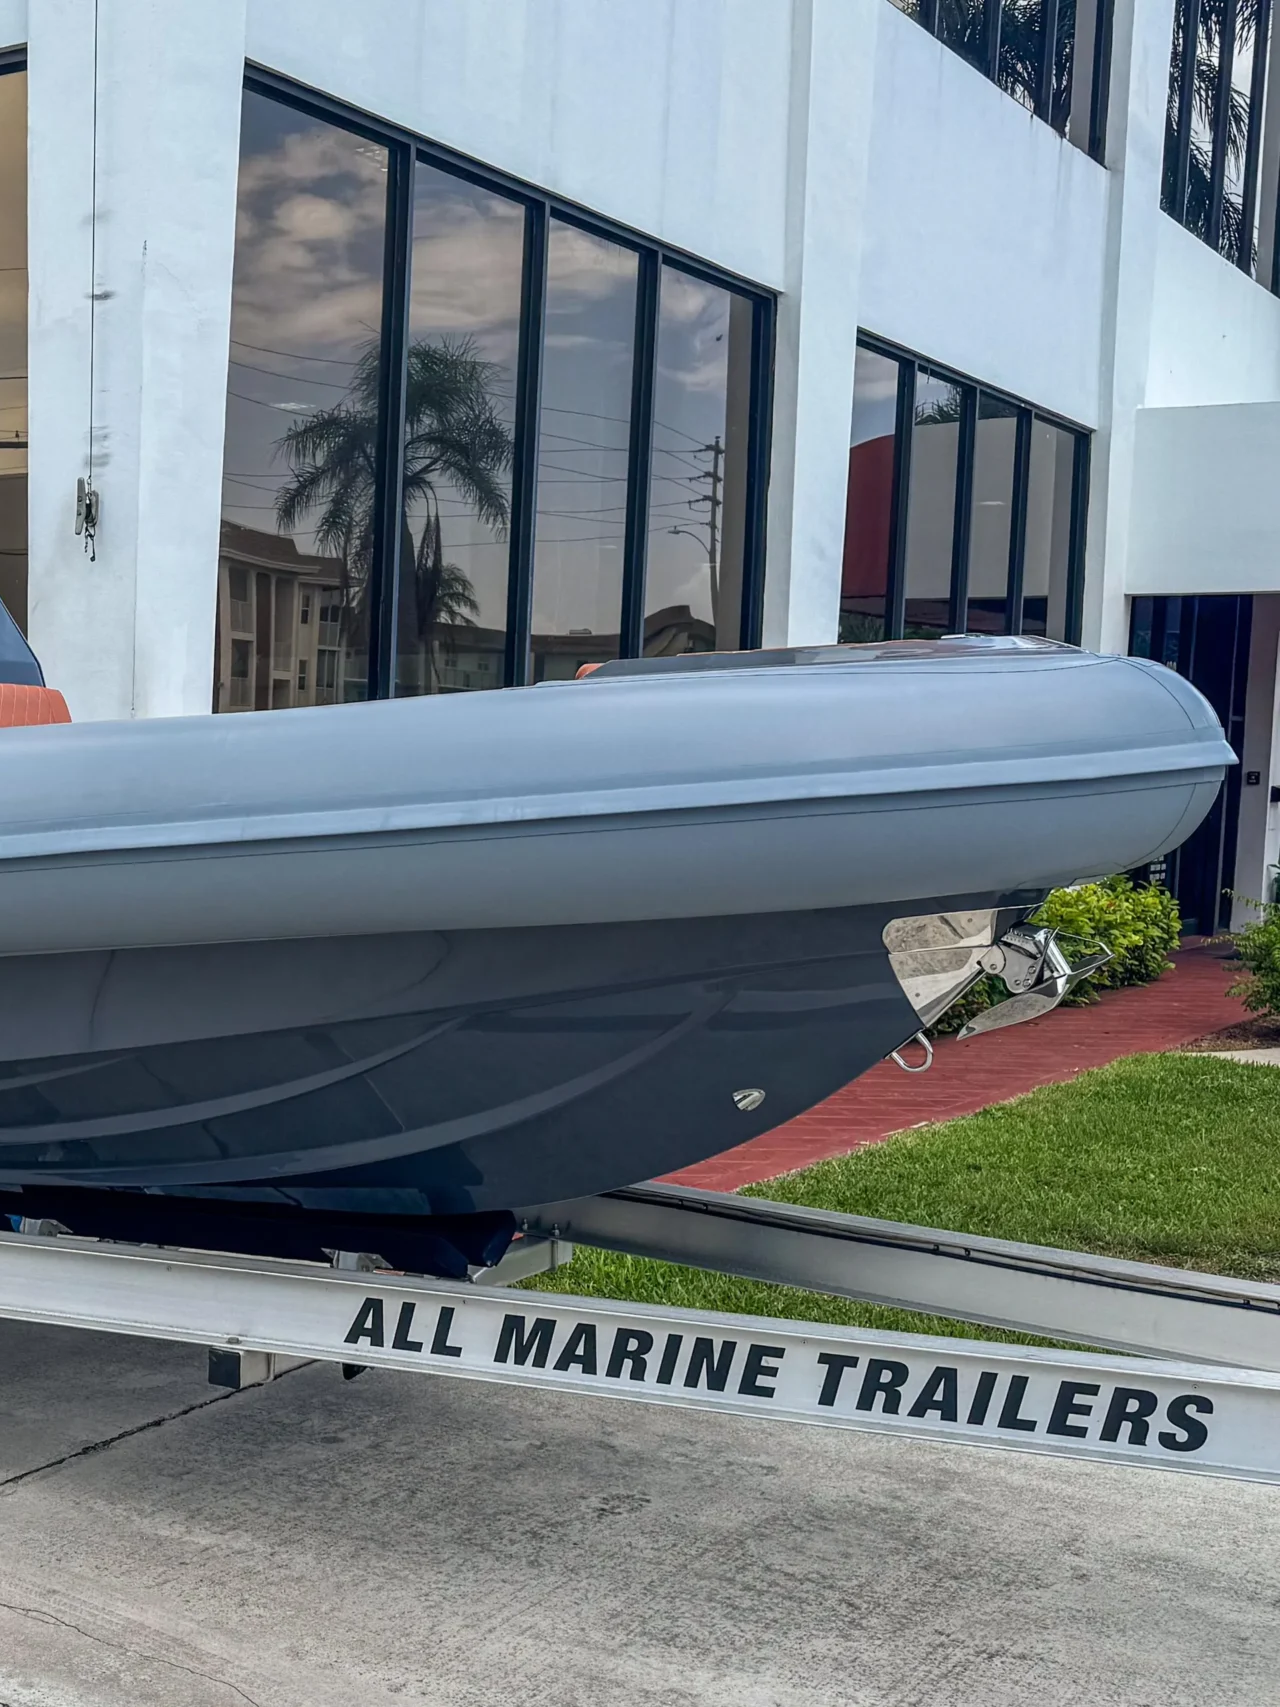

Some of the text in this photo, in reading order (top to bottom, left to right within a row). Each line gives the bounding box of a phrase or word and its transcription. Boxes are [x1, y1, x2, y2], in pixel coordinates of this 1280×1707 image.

[343, 1297, 1215, 1452] ALL MARINE TRAILERS
